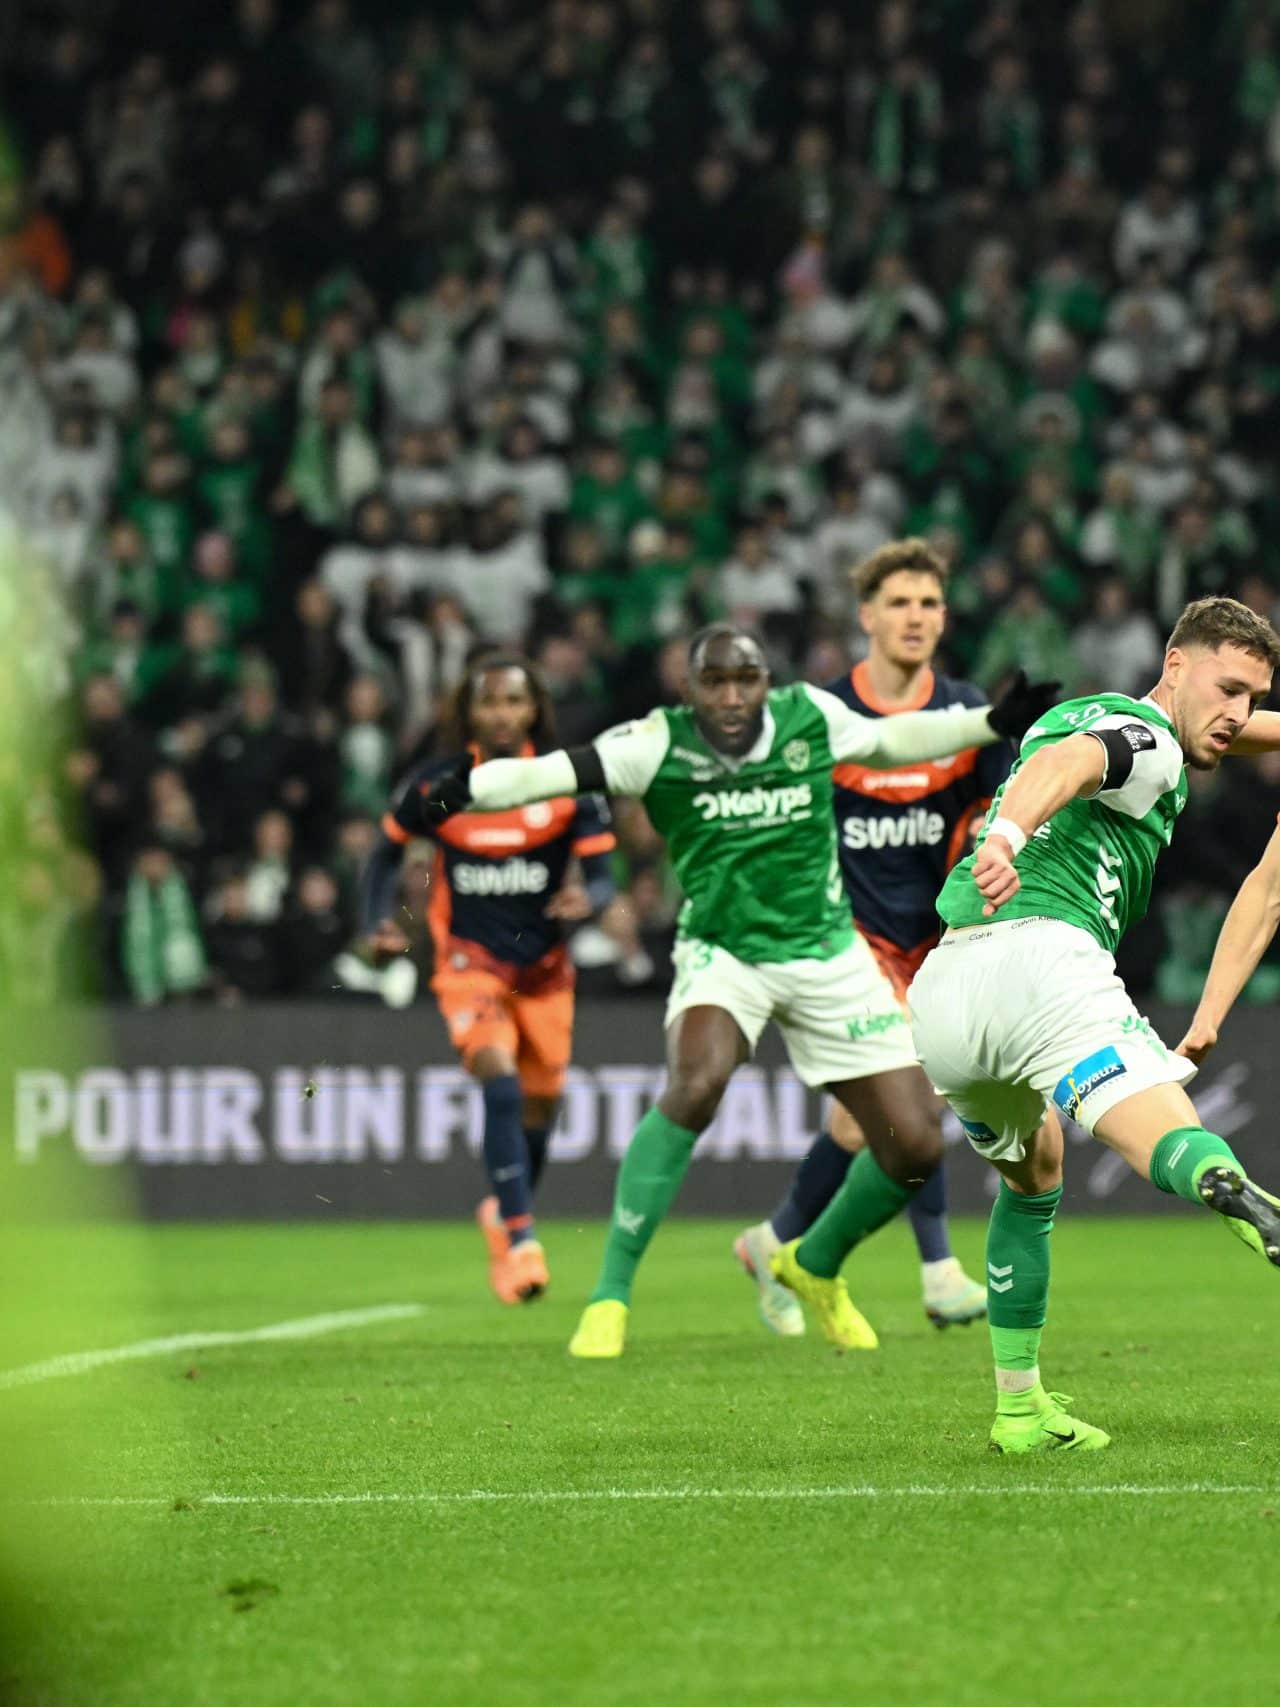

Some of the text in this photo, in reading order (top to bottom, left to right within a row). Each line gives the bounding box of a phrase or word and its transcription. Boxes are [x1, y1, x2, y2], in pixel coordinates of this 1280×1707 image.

[718, 783, 812, 818] Kelyps
[843, 807, 945, 849] swile
[453, 855, 549, 895] swile
[14, 1066, 264, 1163] POUR
[272, 1066, 403, 1163] UN
